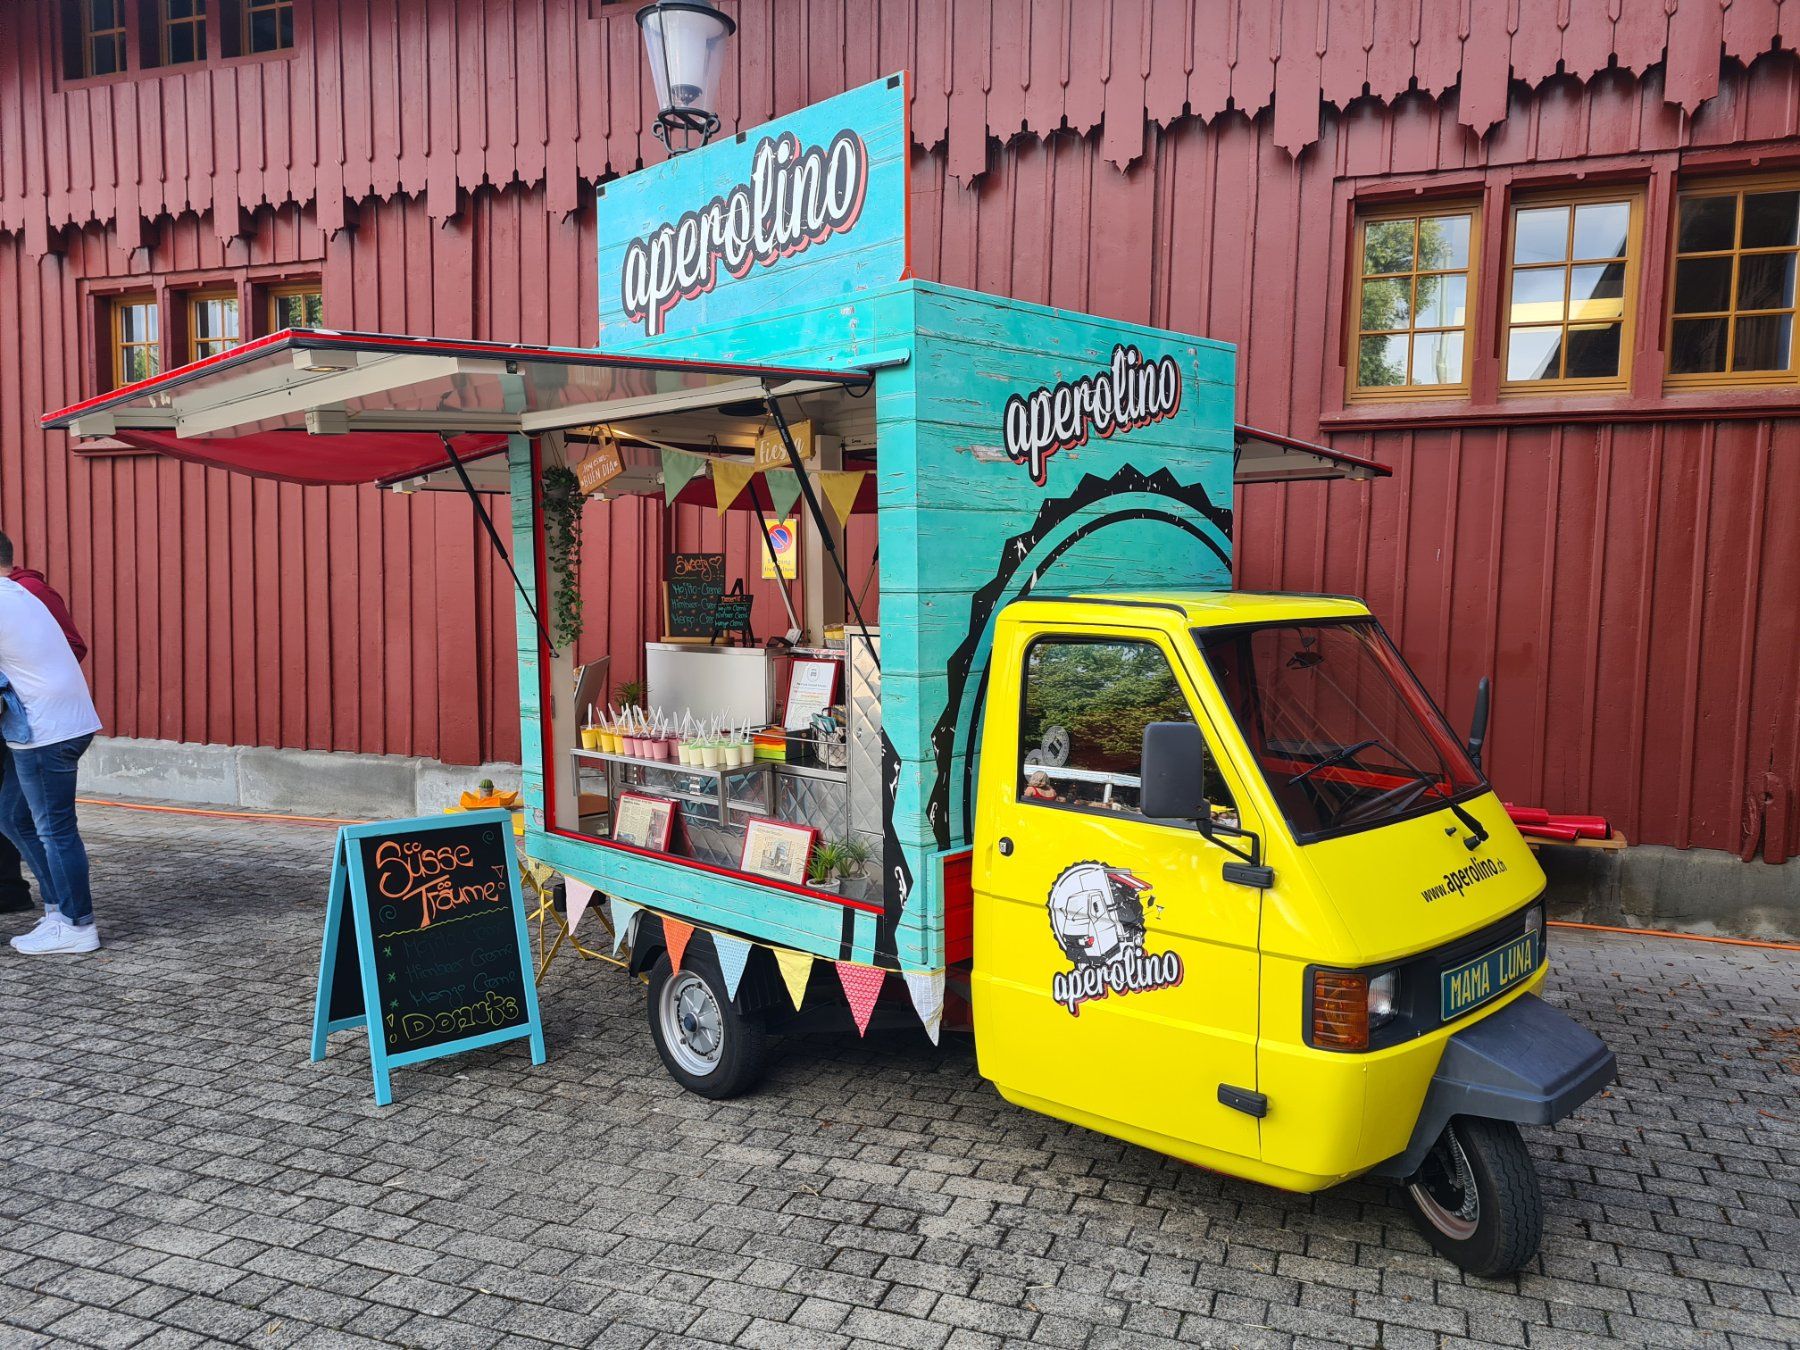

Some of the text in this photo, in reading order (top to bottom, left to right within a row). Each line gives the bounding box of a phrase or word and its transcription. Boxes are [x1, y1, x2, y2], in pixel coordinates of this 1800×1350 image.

[622, 129, 869, 337] aperolino
[760, 437, 804, 464] Fiesa
[1003, 343, 1182, 487] aperolino
[376, 841, 474, 898] Süsse
[1421, 856, 1507, 903] www.aperolino.ch
[1053, 945, 1184, 1017] aperolino
[1450, 939, 1532, 1011] MAMA LUNA
